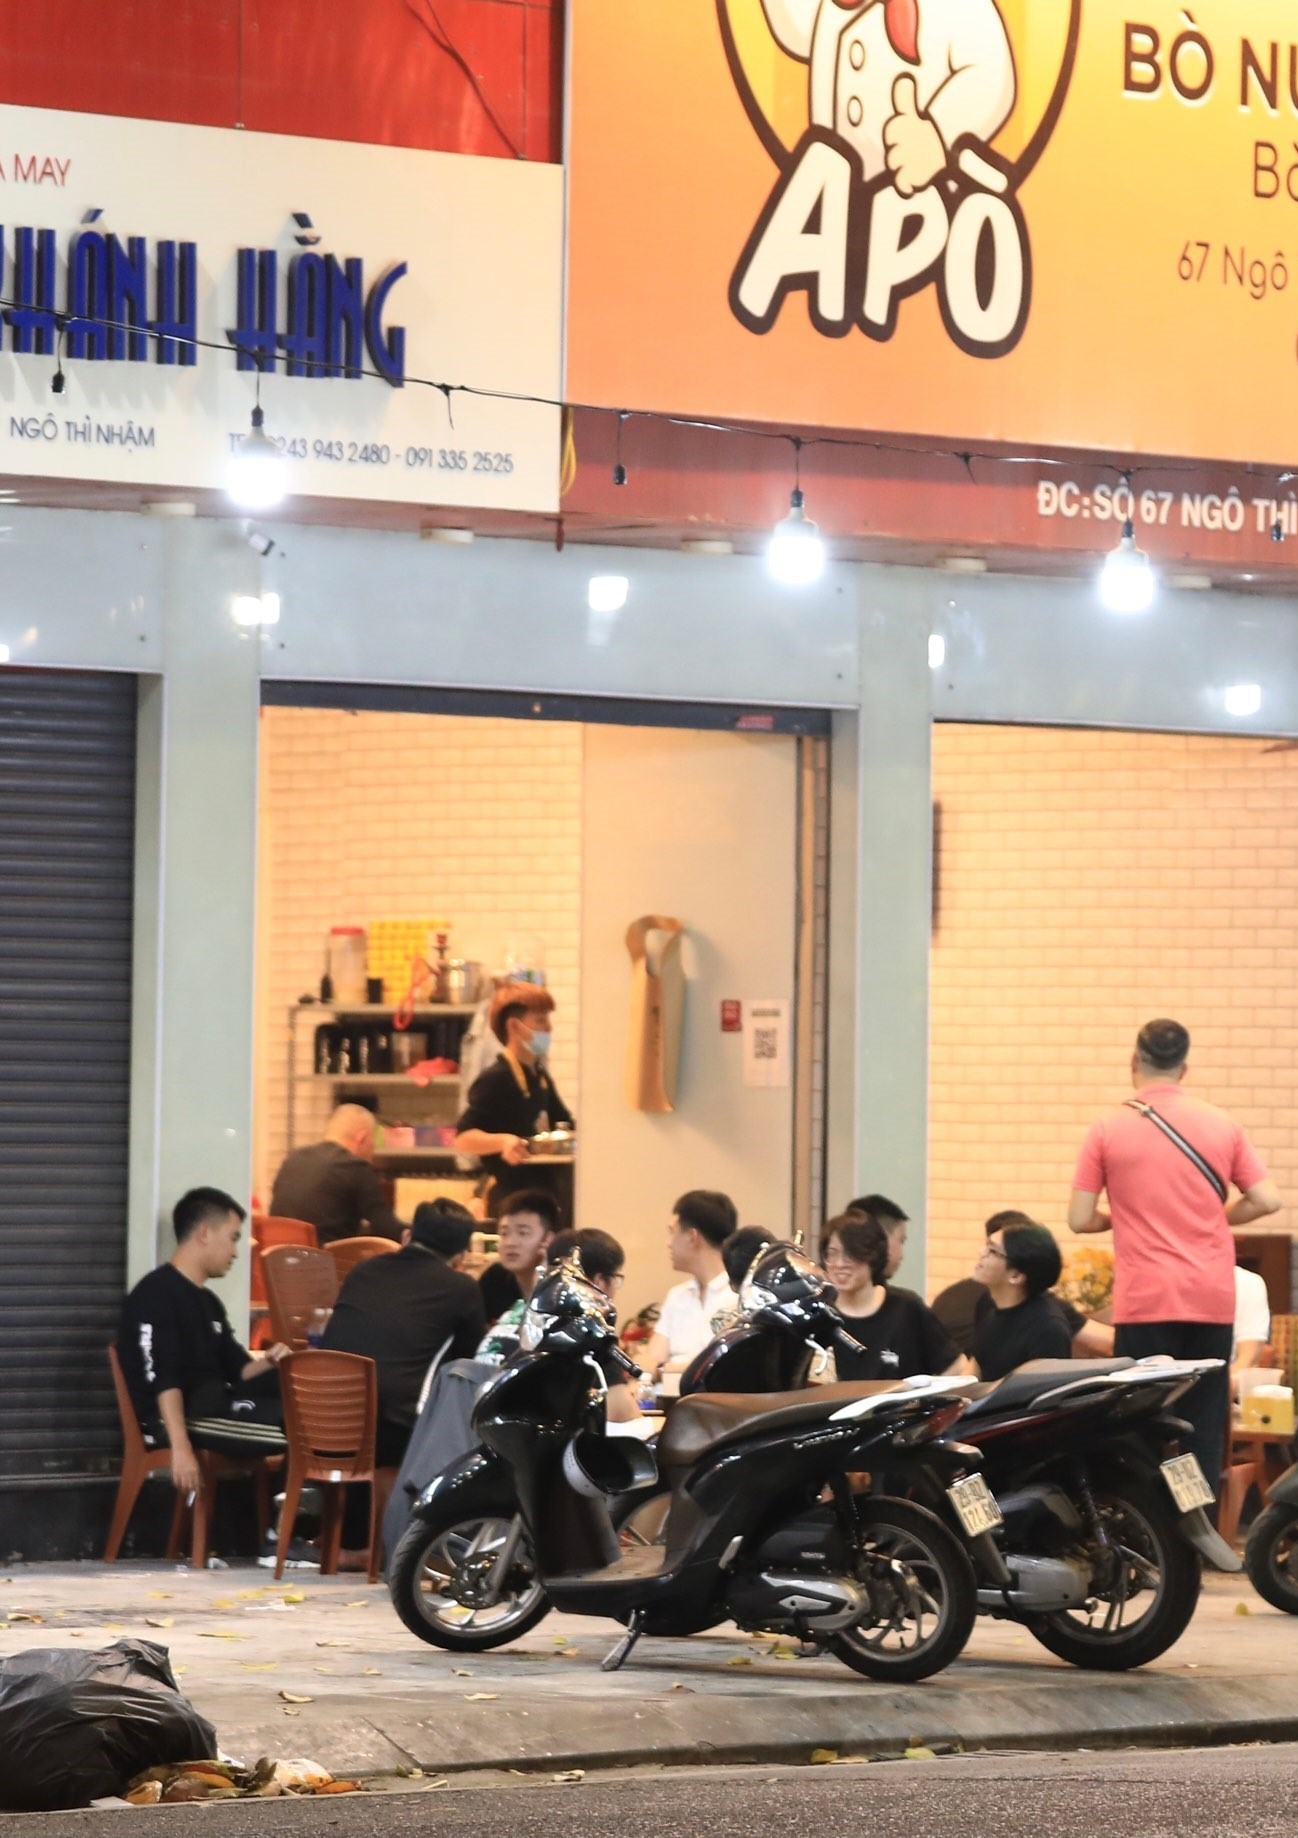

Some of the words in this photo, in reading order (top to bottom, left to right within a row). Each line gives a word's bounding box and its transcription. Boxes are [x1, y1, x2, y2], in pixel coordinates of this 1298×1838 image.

[1123, 8, 1215, 101] BÒ
[14, 153, 72, 187] MAY
[733, 138, 1029, 354] APÒ
[1177, 241, 1210, 282] 67
[1222, 244, 1289, 300] Ngô
[0, 208, 197, 366] HÁNH
[225, 212, 408, 388] HẰNG
[10, 412, 58, 440] NGÔ
[96, 420, 155, 453] NHẬM
[312, 438, 344, 462] 943
[347, 441, 391, 465] 2480
[438, 448, 468, 471] 335
[472, 451, 514, 474] 2525
[1139, 489, 1174, 525] 67
[1181, 485, 1245, 532] NGÔ
